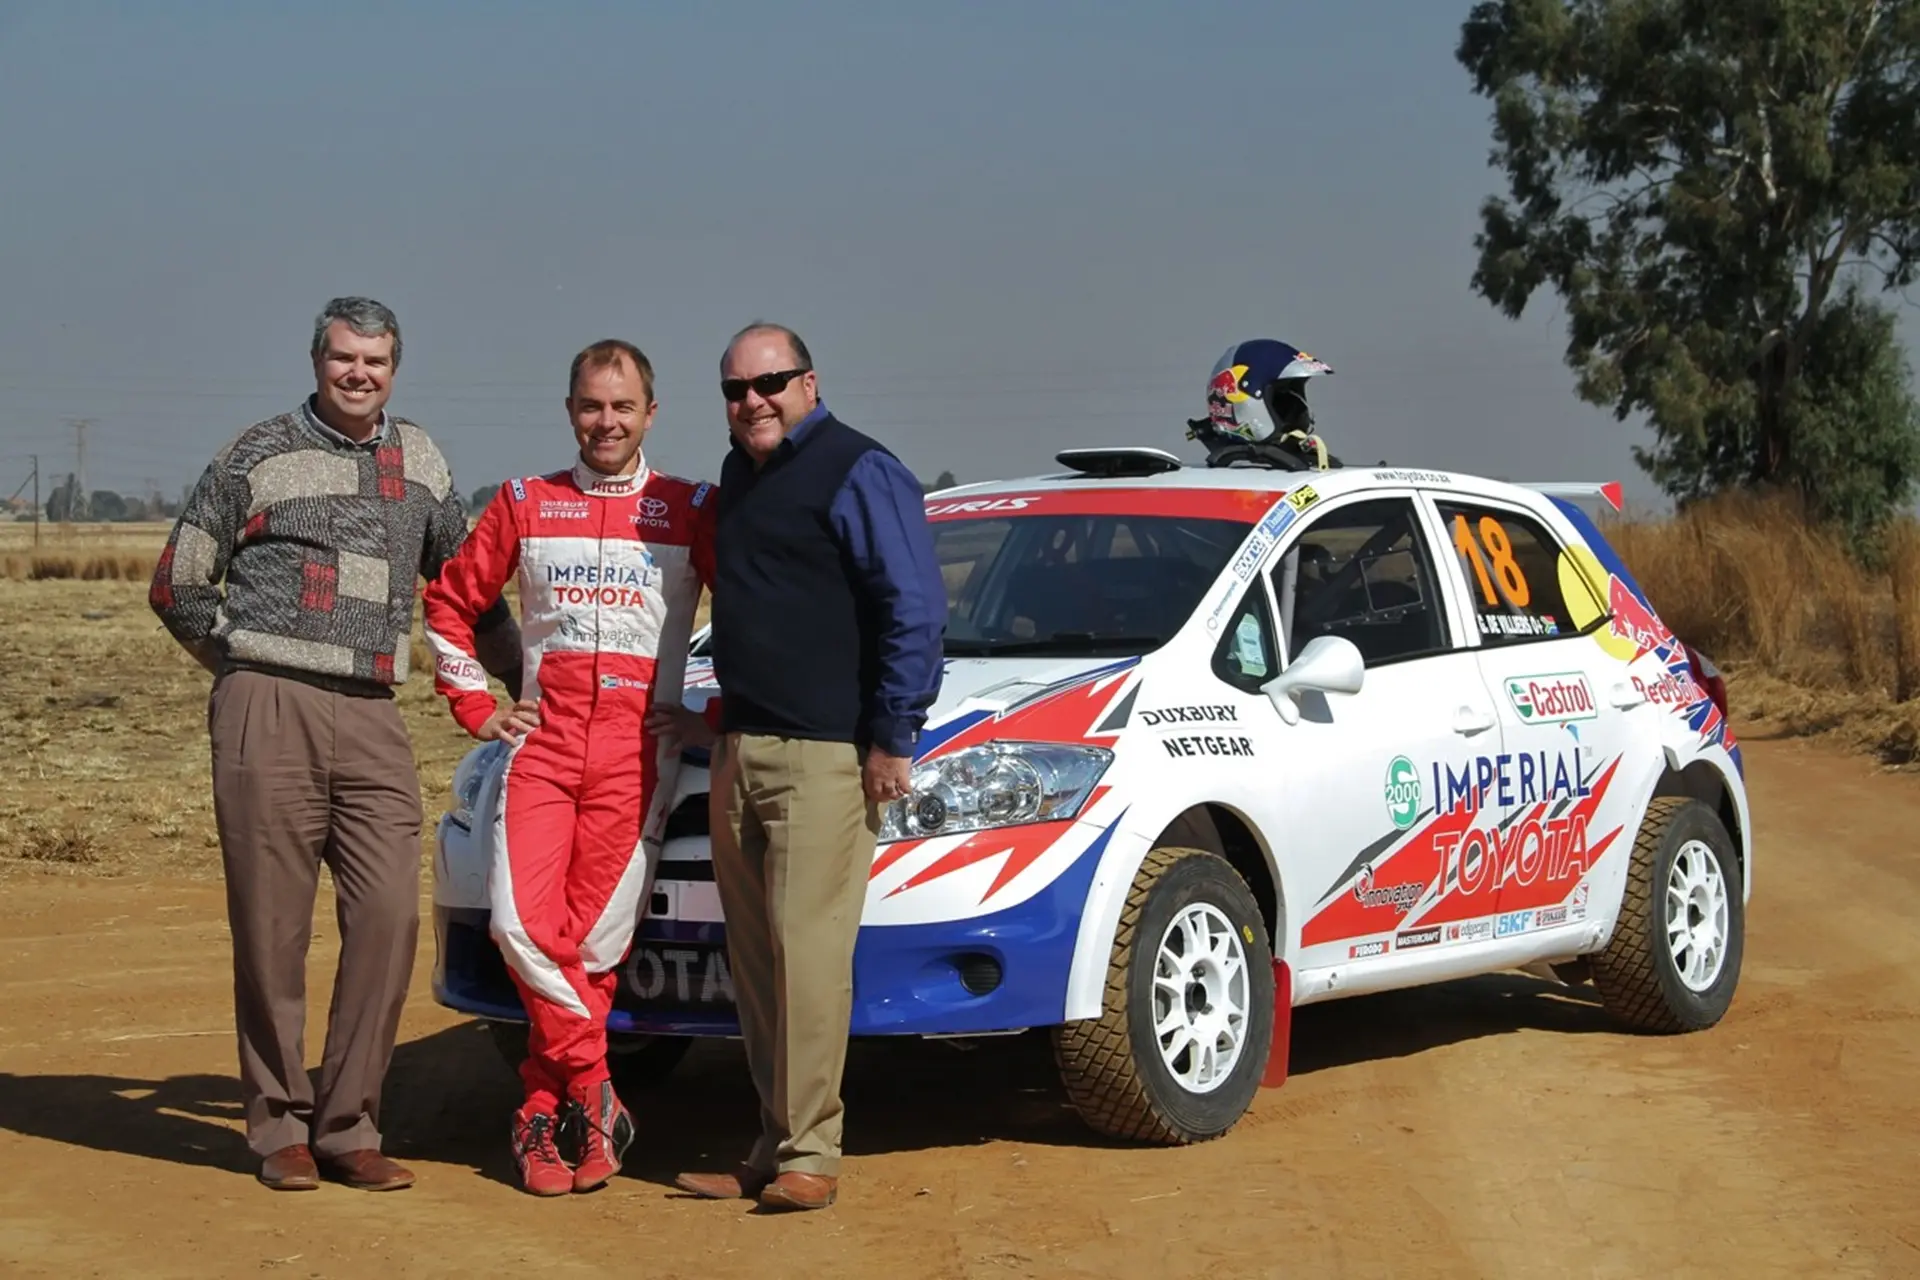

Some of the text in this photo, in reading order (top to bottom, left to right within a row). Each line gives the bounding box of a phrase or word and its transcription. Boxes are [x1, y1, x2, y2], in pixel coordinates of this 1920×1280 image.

[539, 500, 589, 508] DUXBURY
[539, 511, 590, 519] NETGEAR
[925, 496, 1042, 515] URIS
[628, 515, 671, 529] TOYOTA
[1453, 514, 1530, 608] 18
[547, 565, 651, 587] IMPERIAL
[553, 586, 645, 608] TOYOTA
[436, 654, 461, 676] Red
[1528, 678, 1593, 718] Castrol
[1630, 673, 1672, 704] Red
[1138, 704, 1238, 726] DUXBURY
[1162, 736, 1255, 758] NETGEAR
[1432, 747, 1591, 815] IMPERIAL
[1386, 783, 1420, 803] 2000
[1433, 814, 1590, 896] TOYOTA
[1497, 911, 1533, 935] SKF
[626, 948, 734, 1003] OTA
